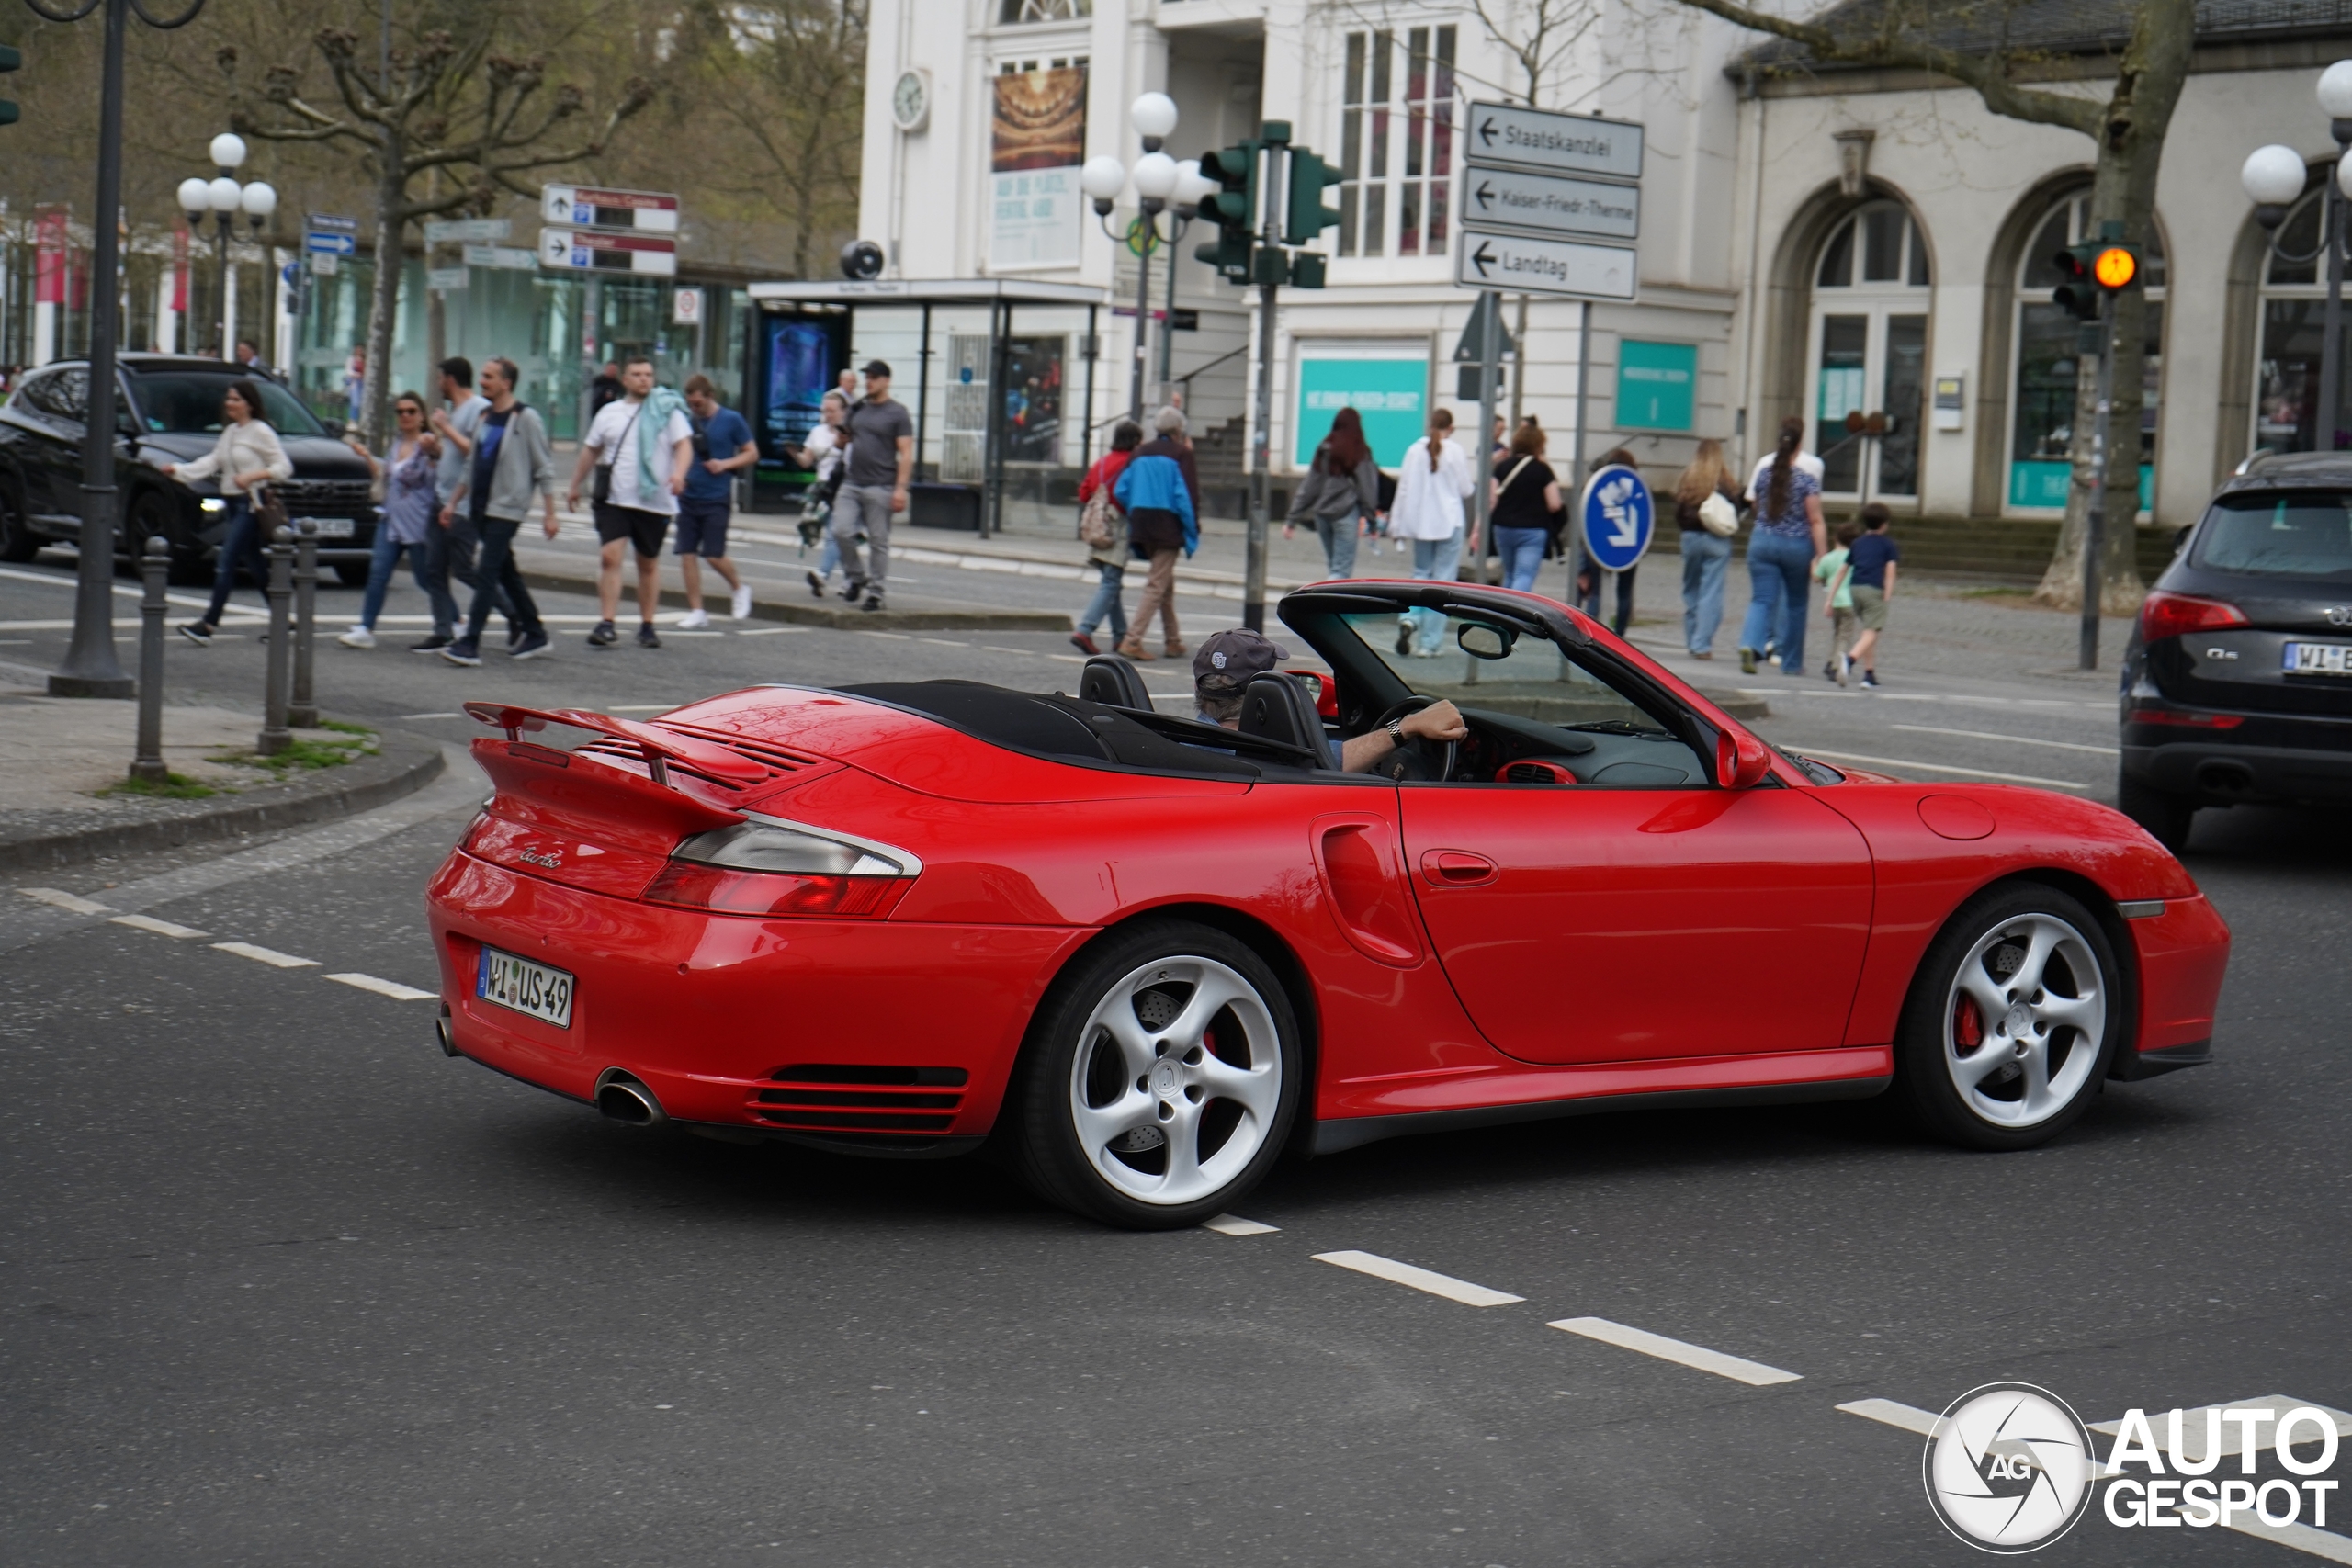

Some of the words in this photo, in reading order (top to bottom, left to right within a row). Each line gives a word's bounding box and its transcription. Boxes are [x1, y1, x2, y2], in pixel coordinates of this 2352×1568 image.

[1506, 125, 1611, 156] Staatskanzlei
[1501, 188, 1633, 220] Kaiser-Friedr.-Therme
[1502, 251, 1567, 281] Landtag
[2300, 647, 2326, 668] WI
[487, 955, 508, 999] WI
